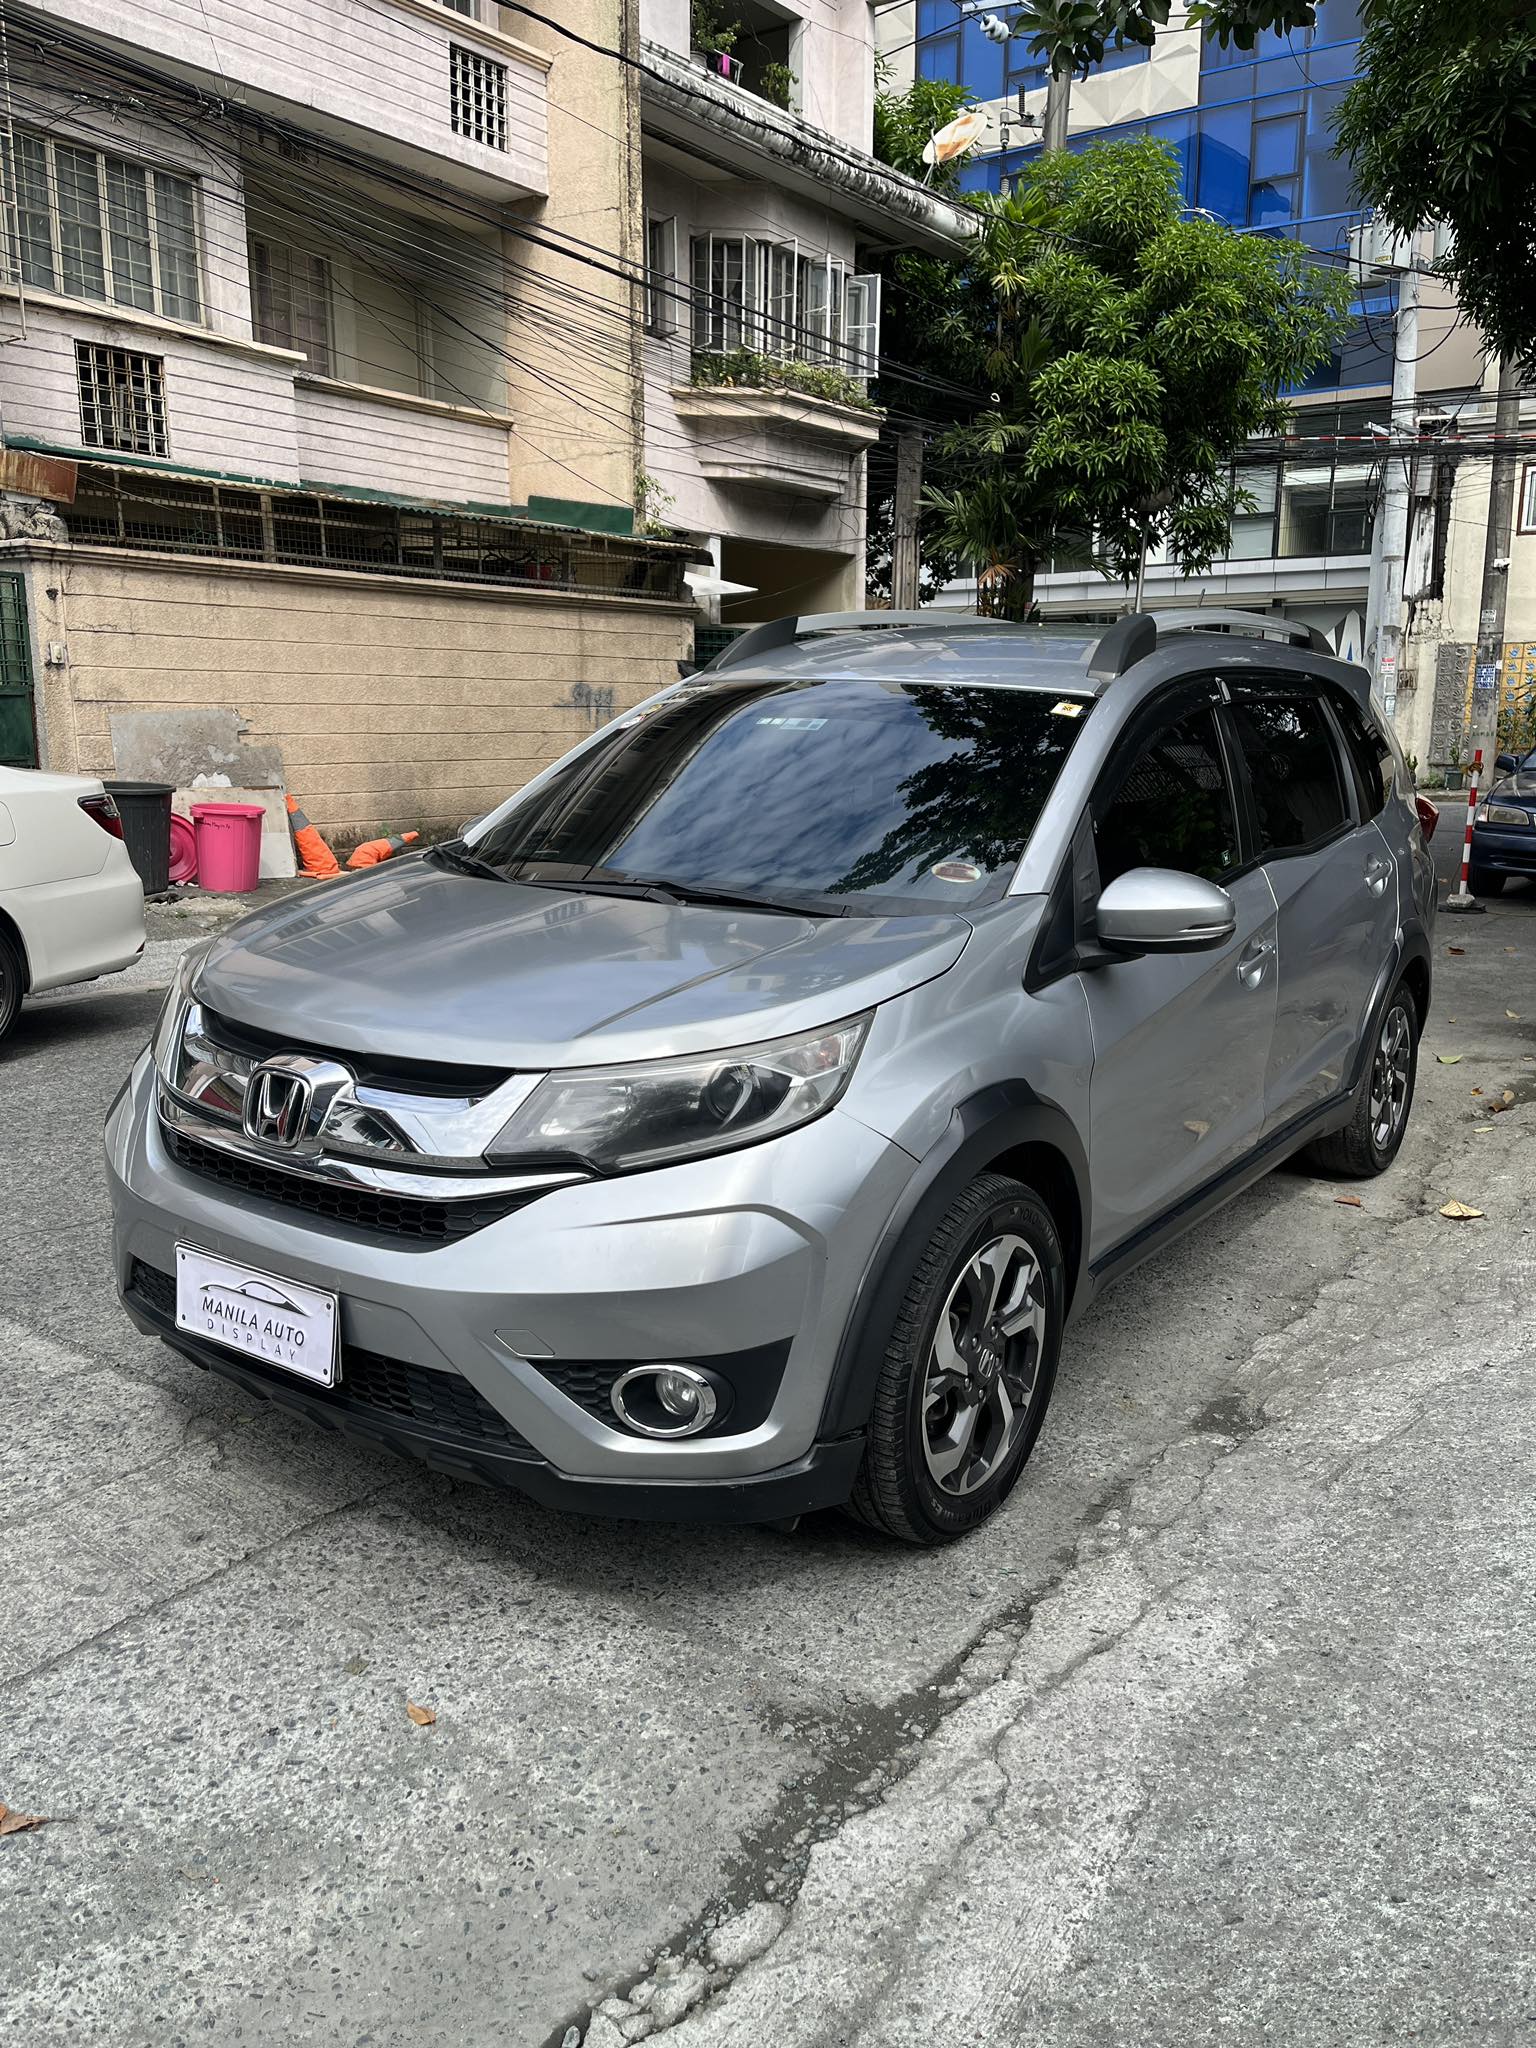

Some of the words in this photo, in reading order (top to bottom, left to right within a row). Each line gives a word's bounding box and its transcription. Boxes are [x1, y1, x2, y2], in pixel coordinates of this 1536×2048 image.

[202, 1296, 258, 1330] MANILA
[263, 1319, 305, 1347] AUTO
[207, 1318, 296, 1361] DISPLAY
